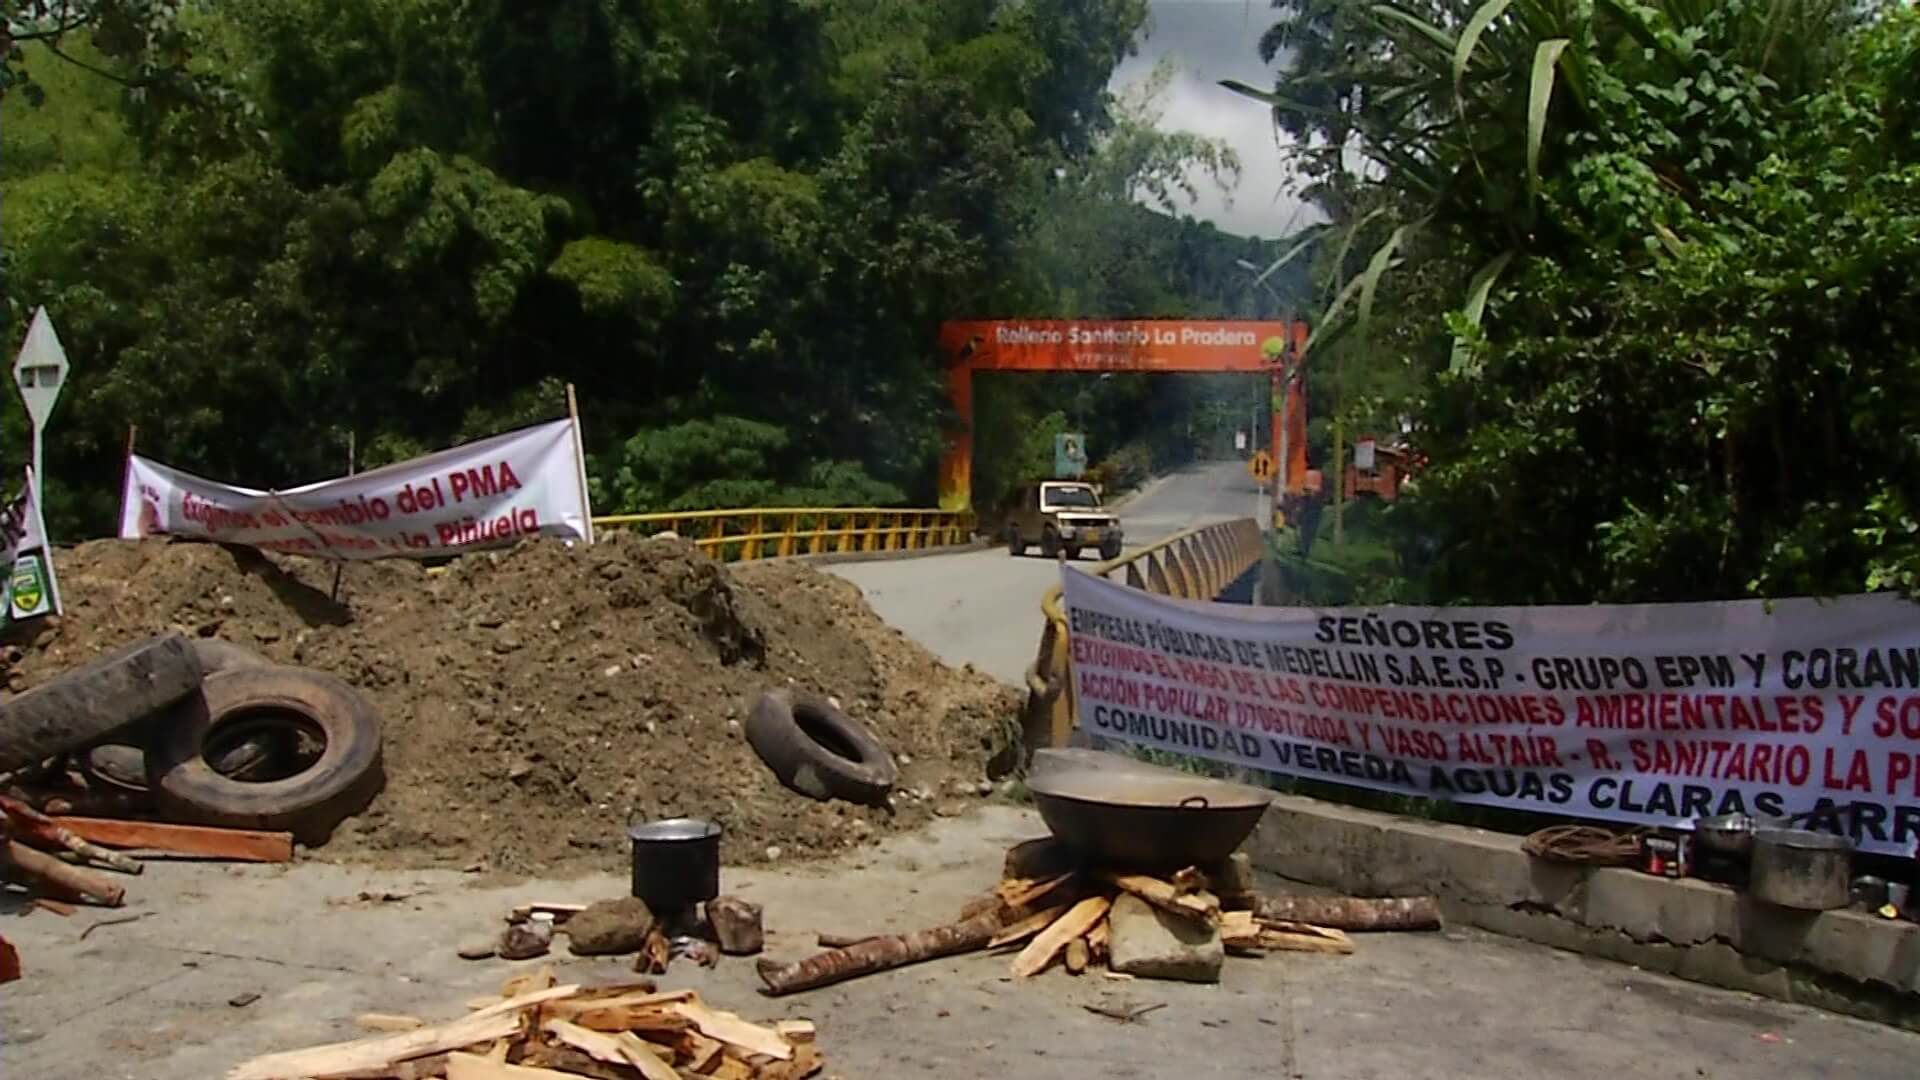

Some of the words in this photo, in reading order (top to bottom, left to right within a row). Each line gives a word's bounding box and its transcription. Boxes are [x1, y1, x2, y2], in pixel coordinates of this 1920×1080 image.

[1067, 326, 1149, 345] Sanitario
[1154, 328, 1175, 345] La
[1181, 327, 1257, 345] Pradera
[398, 478, 445, 514] del
[449, 461, 522, 502] PMA
[435, 507, 540, 546] Piñuela
[1071, 607, 1146, 648] EMPRESAS
[1149, 619, 1233, 664] PÚBLICAS
[1233, 638, 1264, 669] DE
[1264, 641, 1381, 684] MEDELLIN
[1532, 657, 1648, 690] GRUPO
[1655, 655, 1735, 688] EPM
[1741, 653, 1766, 688] Y
[1315, 613, 1514, 650] SEÑORES
[1072, 637, 1152, 675] EXIGIMOS
[1152, 654, 1178, 681] EL
[1180, 656, 1230, 690] PAGO
[1230, 670, 1261, 697] DE
[1263, 674, 1304, 705] LAS
[1308, 680, 1565, 728] COMPENSACIONES
[1576, 693, 1824, 733] AMBIENTALES
[1838, 694, 1864, 735] Y
[1094, 705, 1261, 758] COMUNIDAD
[1271, 739, 1416, 786] VEREDA
[1430, 765, 1574, 803] AGUAS
[1589, 777, 1784, 818] CLARAS
[1143, 684, 1229, 723] POPULAR
[1353, 722, 1370, 750] Y
[1376, 725, 1448, 761] VASO
[1458, 727, 1563, 768] ALTAÍR
[1586, 738, 1622, 770] R.
[1630, 739, 1810, 786] SANITARIO
[1824, 747, 1871, 793] LA
[1887, 752, 1920, 798] P
